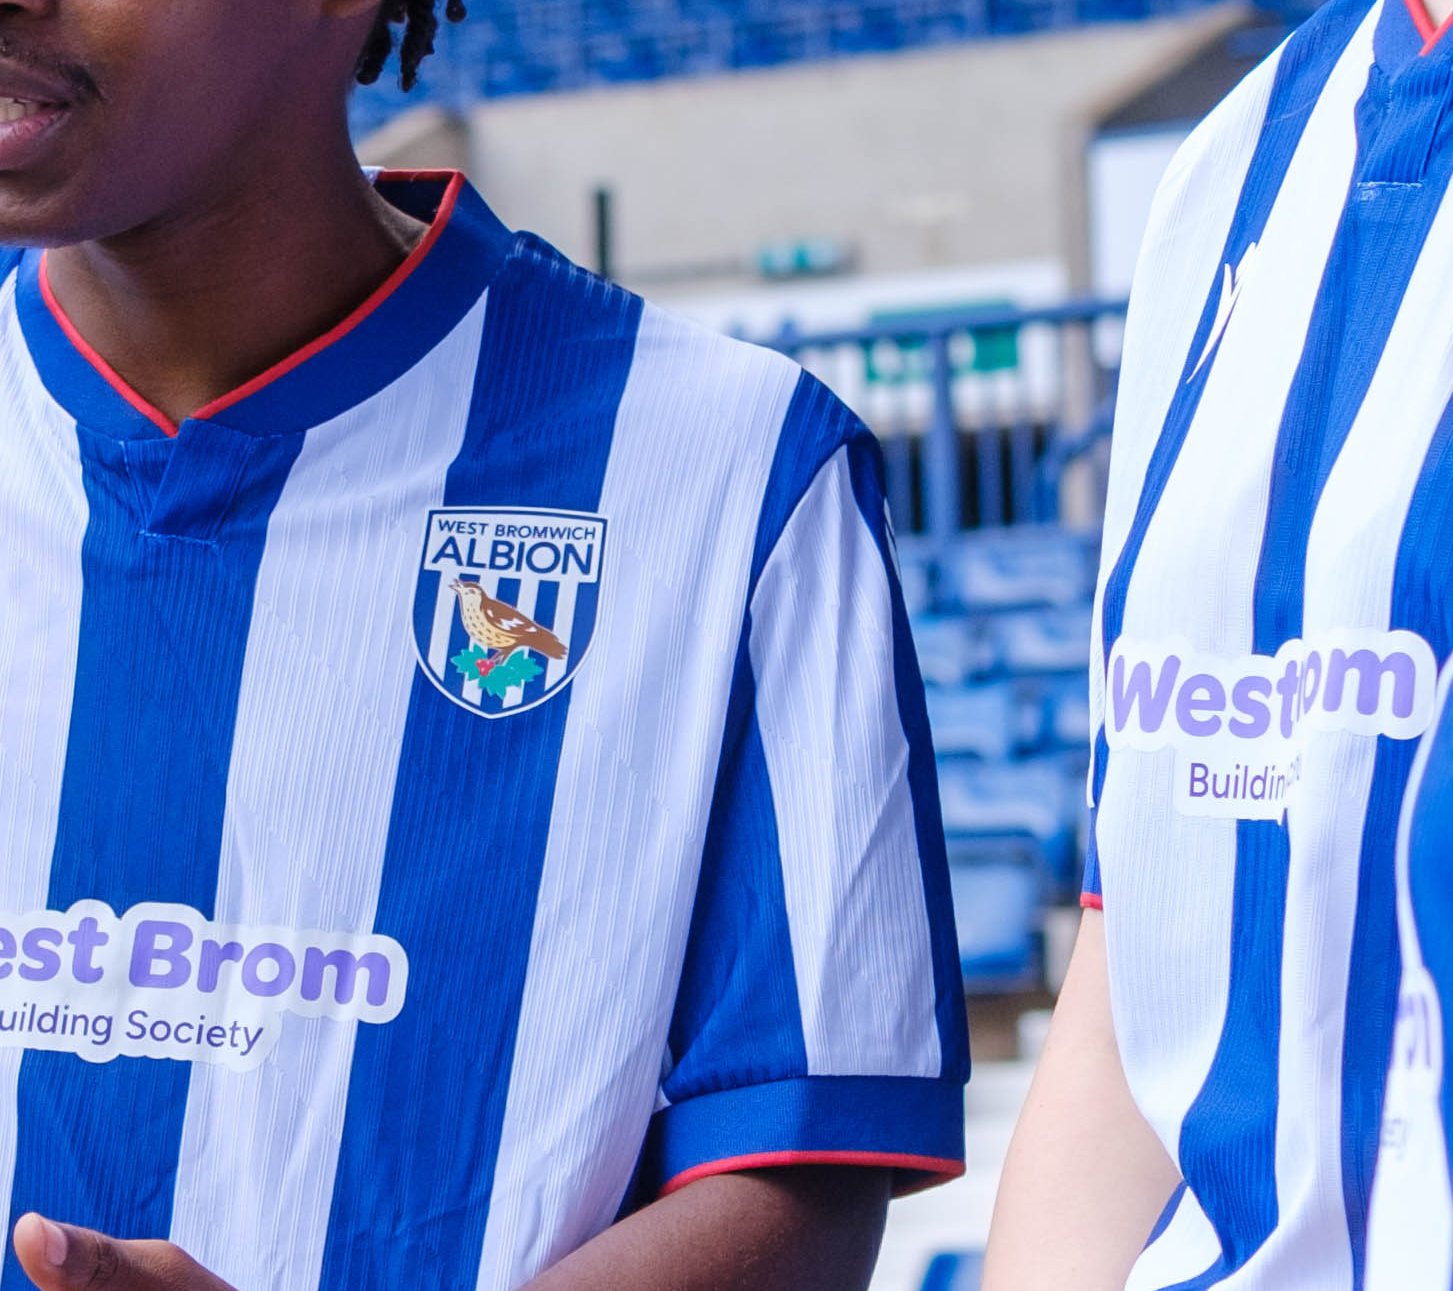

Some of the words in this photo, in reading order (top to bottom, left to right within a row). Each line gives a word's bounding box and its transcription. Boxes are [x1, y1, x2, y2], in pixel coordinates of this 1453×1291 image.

[437, 518, 489, 537] WEST
[494, 523, 596, 541] BROMWICH
[431, 535, 593, 576] ALBION
[1112, 654, 1300, 740] West
[1188, 761, 1286, 801] Buildin
[128, 919, 391, 1008] Brom
[125, 1009, 265, 1056] Society
